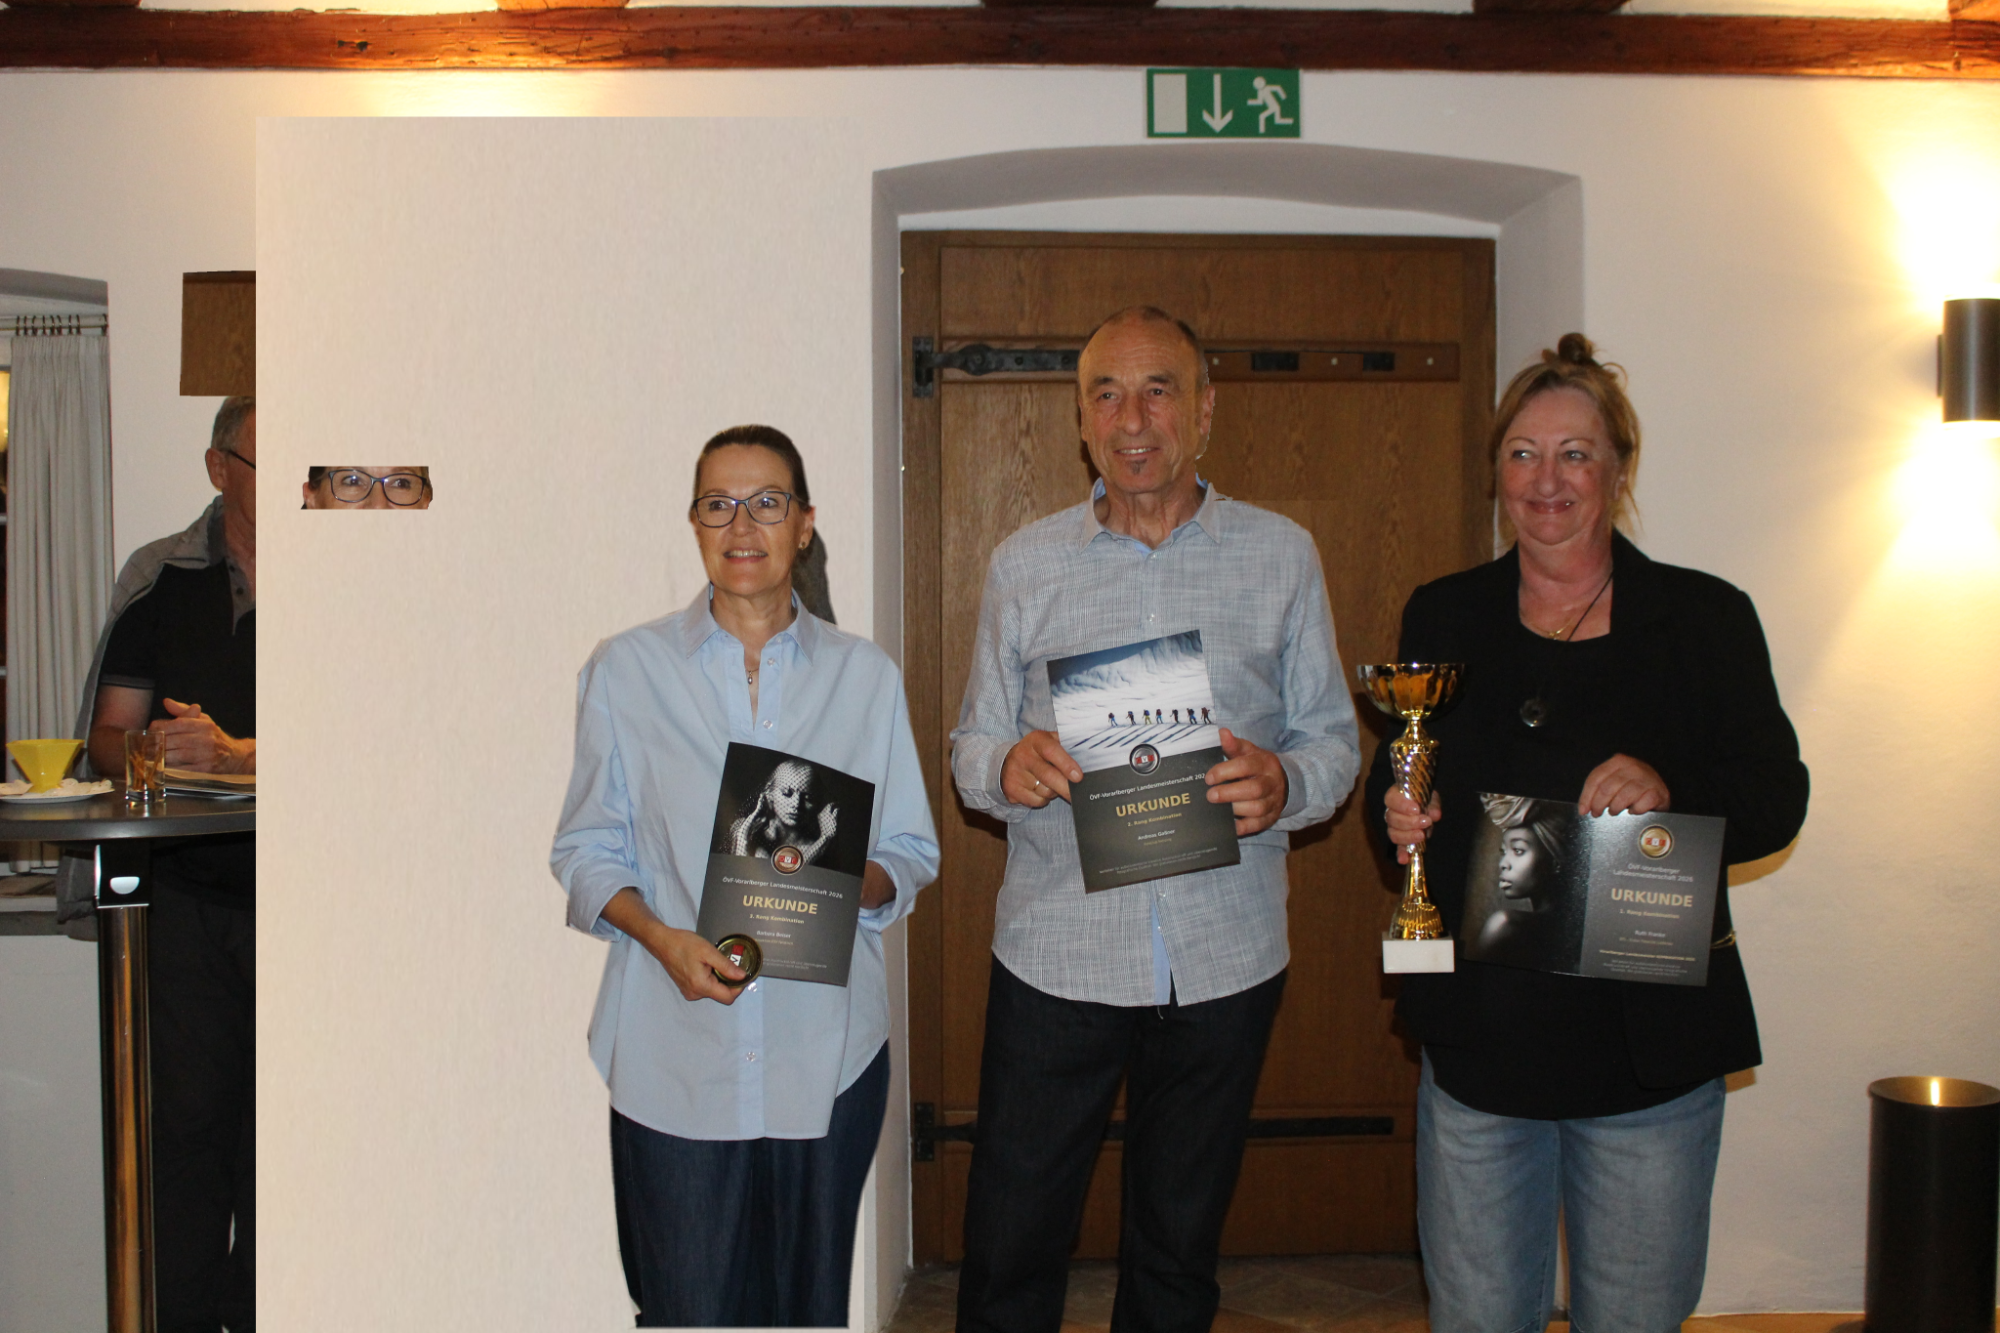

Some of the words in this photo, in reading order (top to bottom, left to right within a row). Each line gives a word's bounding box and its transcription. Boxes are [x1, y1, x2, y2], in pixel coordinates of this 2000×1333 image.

[1136, 775, 1194, 792] Landesmeisterschaft
[1194, 773, 1206, 781] 202
[1115, 792, 1191, 817] URKUNDE
[769, 882, 828, 896] Landesmeisterschaft
[1611, 887, 1694, 908] URKUNDE
[742, 894, 819, 915] URKUNDE
